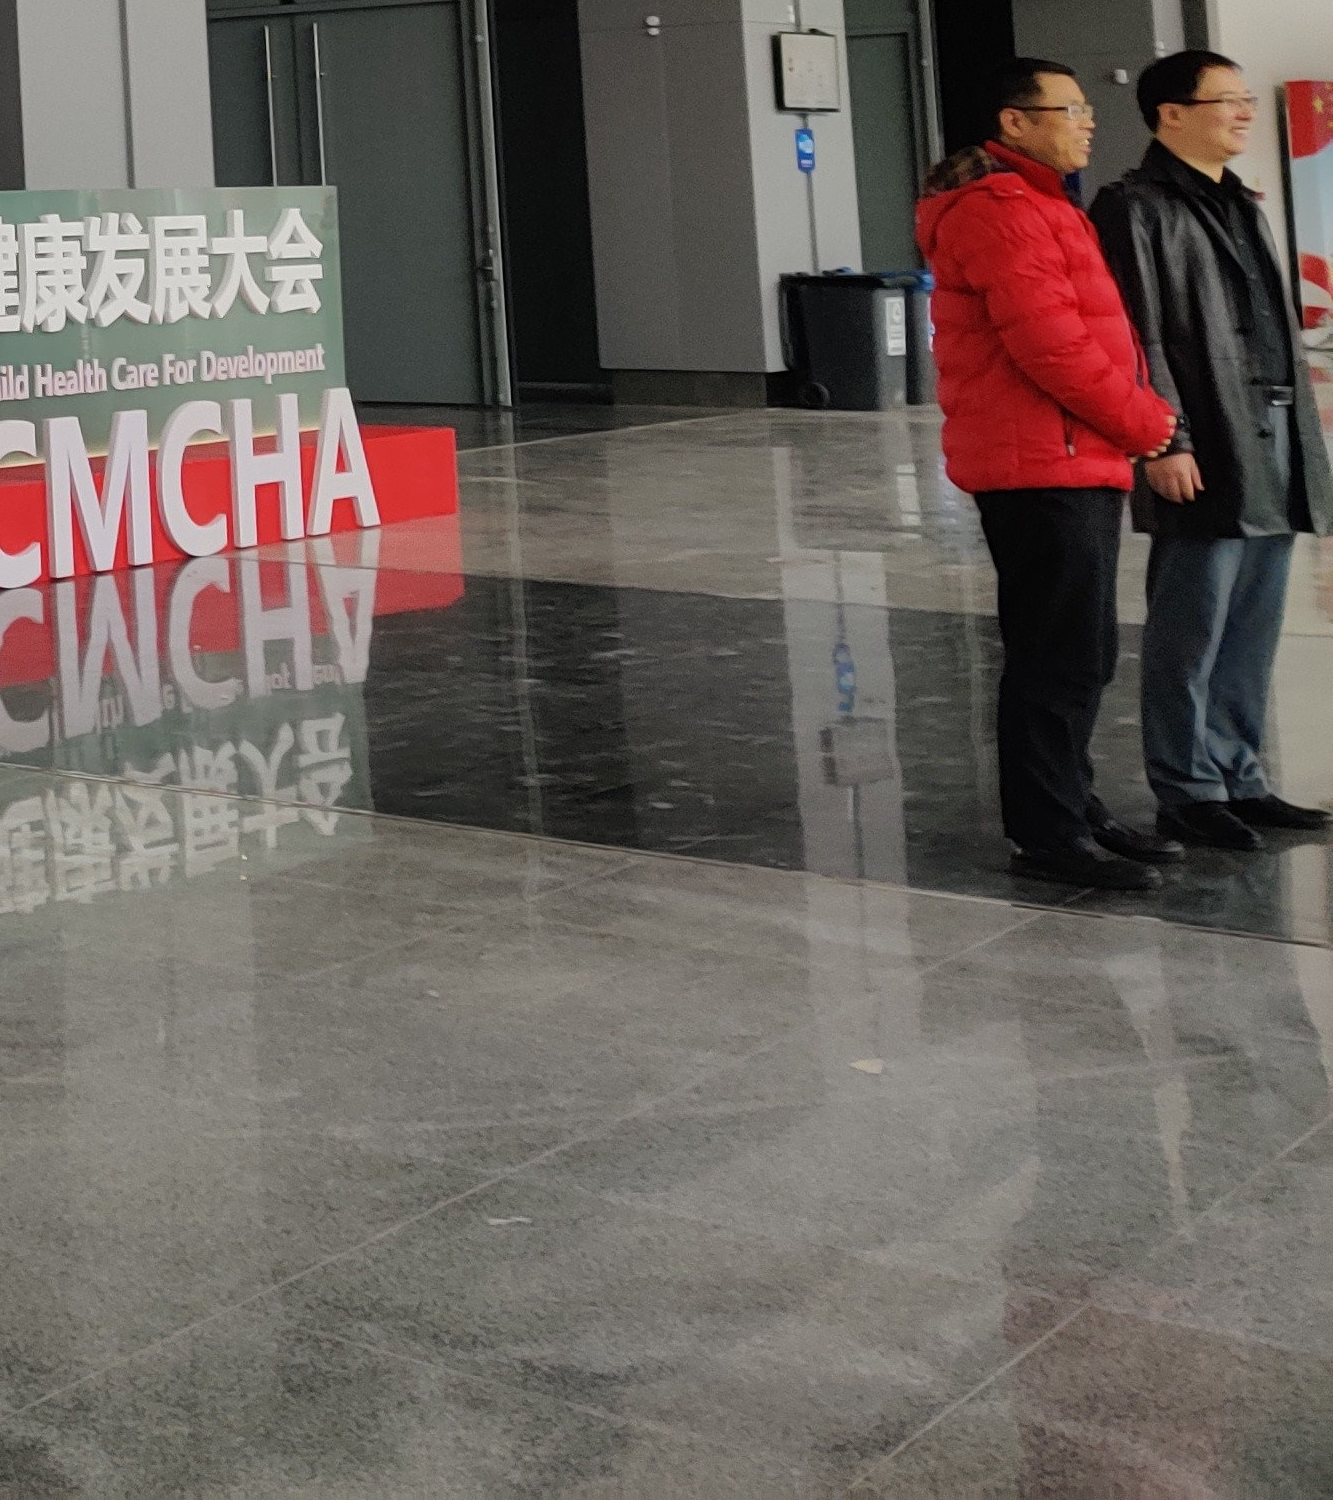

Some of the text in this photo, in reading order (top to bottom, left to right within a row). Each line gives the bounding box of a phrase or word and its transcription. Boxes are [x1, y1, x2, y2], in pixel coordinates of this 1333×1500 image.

[34, 358, 108, 397] Health
[111, 357, 160, 390] Care
[162, 353, 198, 385] For
[200, 343, 326, 384] Development
